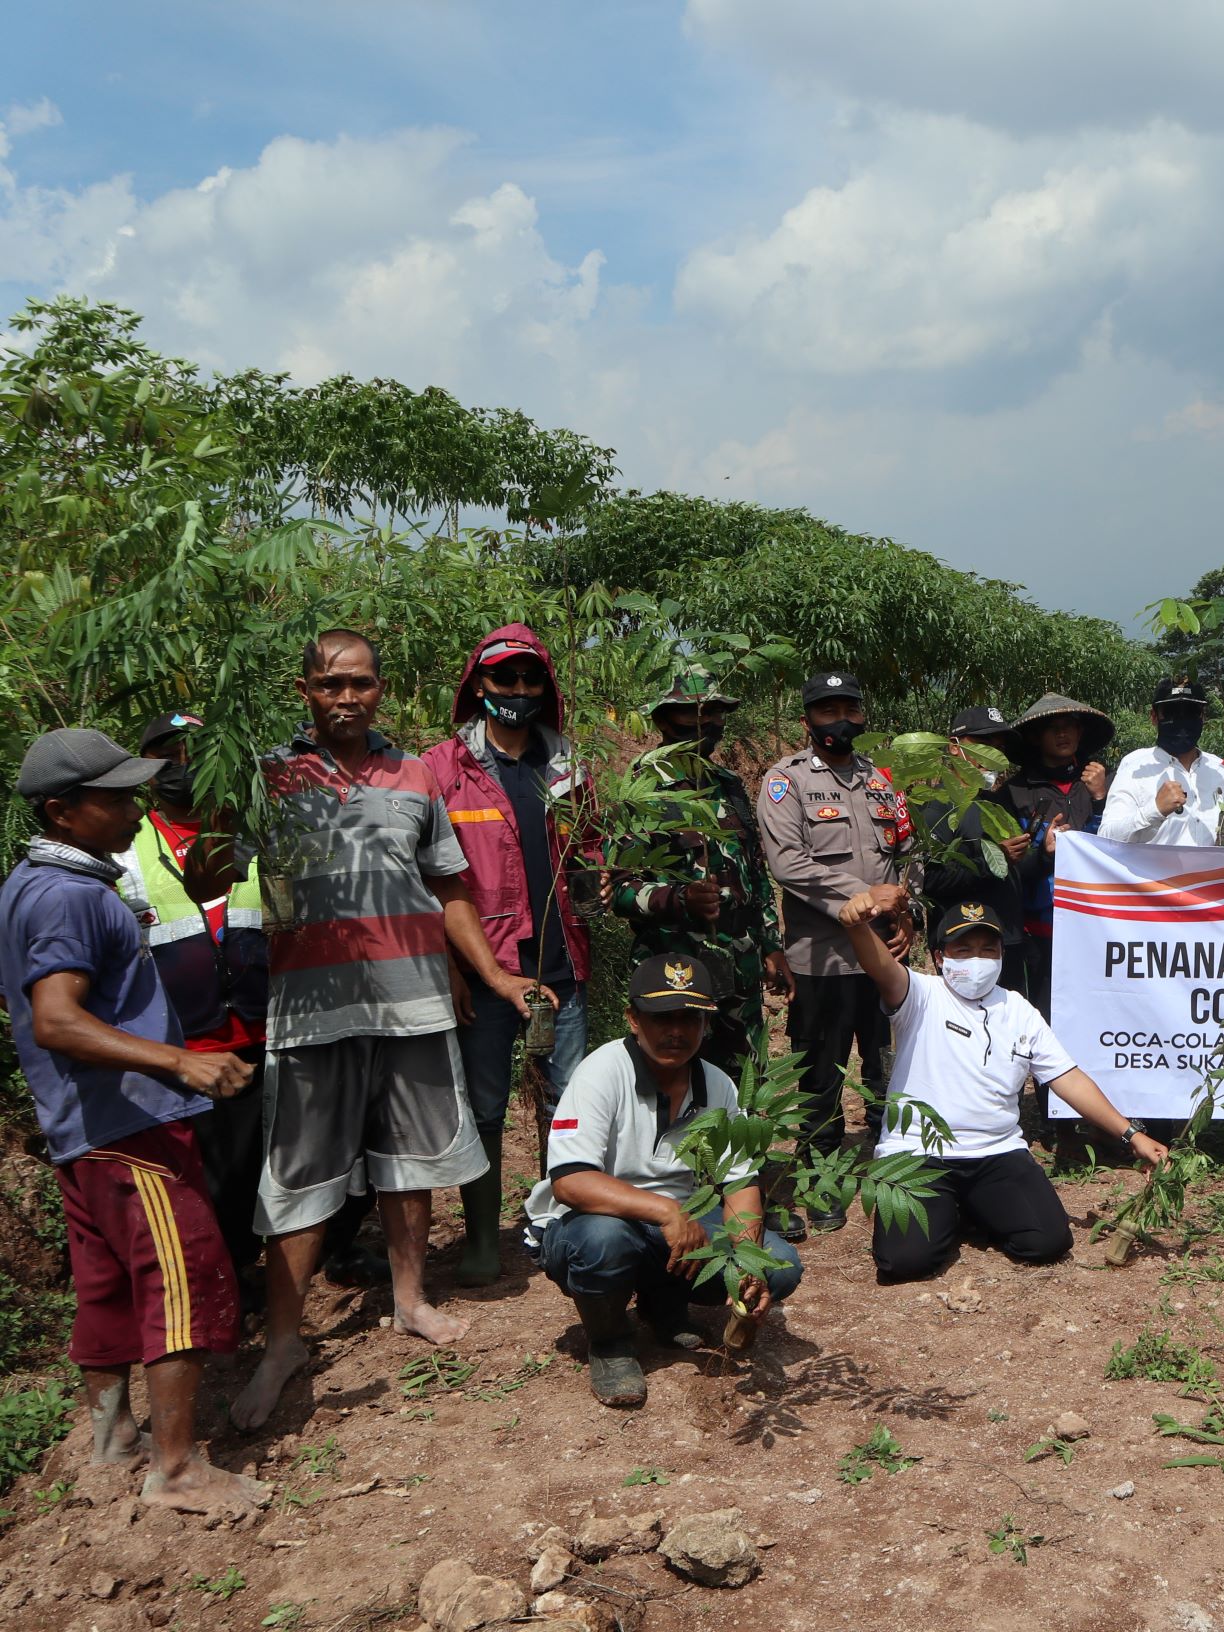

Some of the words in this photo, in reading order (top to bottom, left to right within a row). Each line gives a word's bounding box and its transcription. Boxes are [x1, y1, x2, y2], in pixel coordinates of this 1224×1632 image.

[499, 706, 517, 720] DESA
[865, 791, 894, 801] POLRI
[1114, 1052, 1170, 1069] DESA
